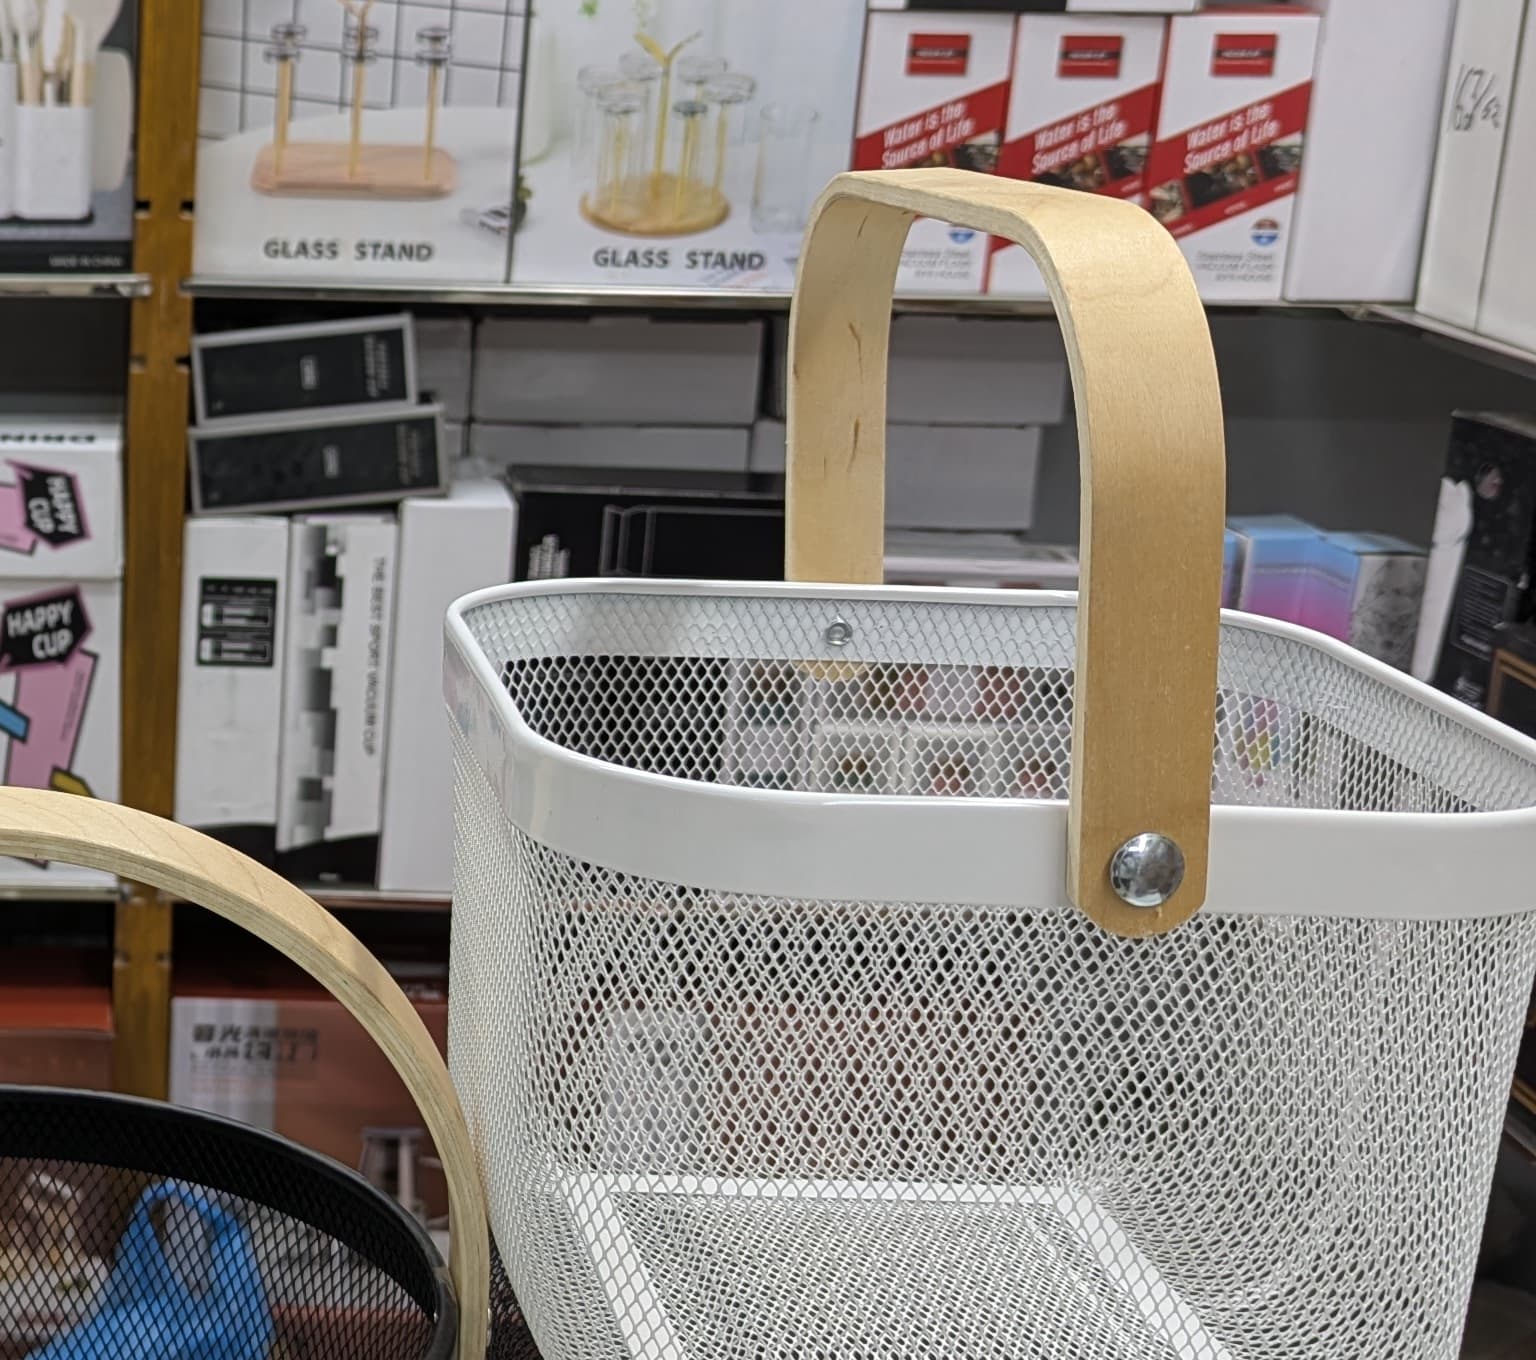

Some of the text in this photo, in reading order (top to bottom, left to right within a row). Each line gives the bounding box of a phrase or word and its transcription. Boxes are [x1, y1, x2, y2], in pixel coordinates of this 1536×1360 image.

[882, 118, 975, 169] Source of Life
[884, 101, 963, 147] Water is the
[1032, 120, 1127, 174] Source of Life
[1034, 104, 1116, 151] Water is the
[1184, 118, 1281, 174] Source of Life
[1187, 103, 1273, 151] Water is the
[263, 240, 435, 263] GLASS STAND
[594, 247, 766, 272] GLASS STAND
[27, 496, 56, 534] CUP
[48, 476, 80, 536] HAPPY
[6, 601, 74, 638] HAPPY
[31, 630, 73, 658] CUP
